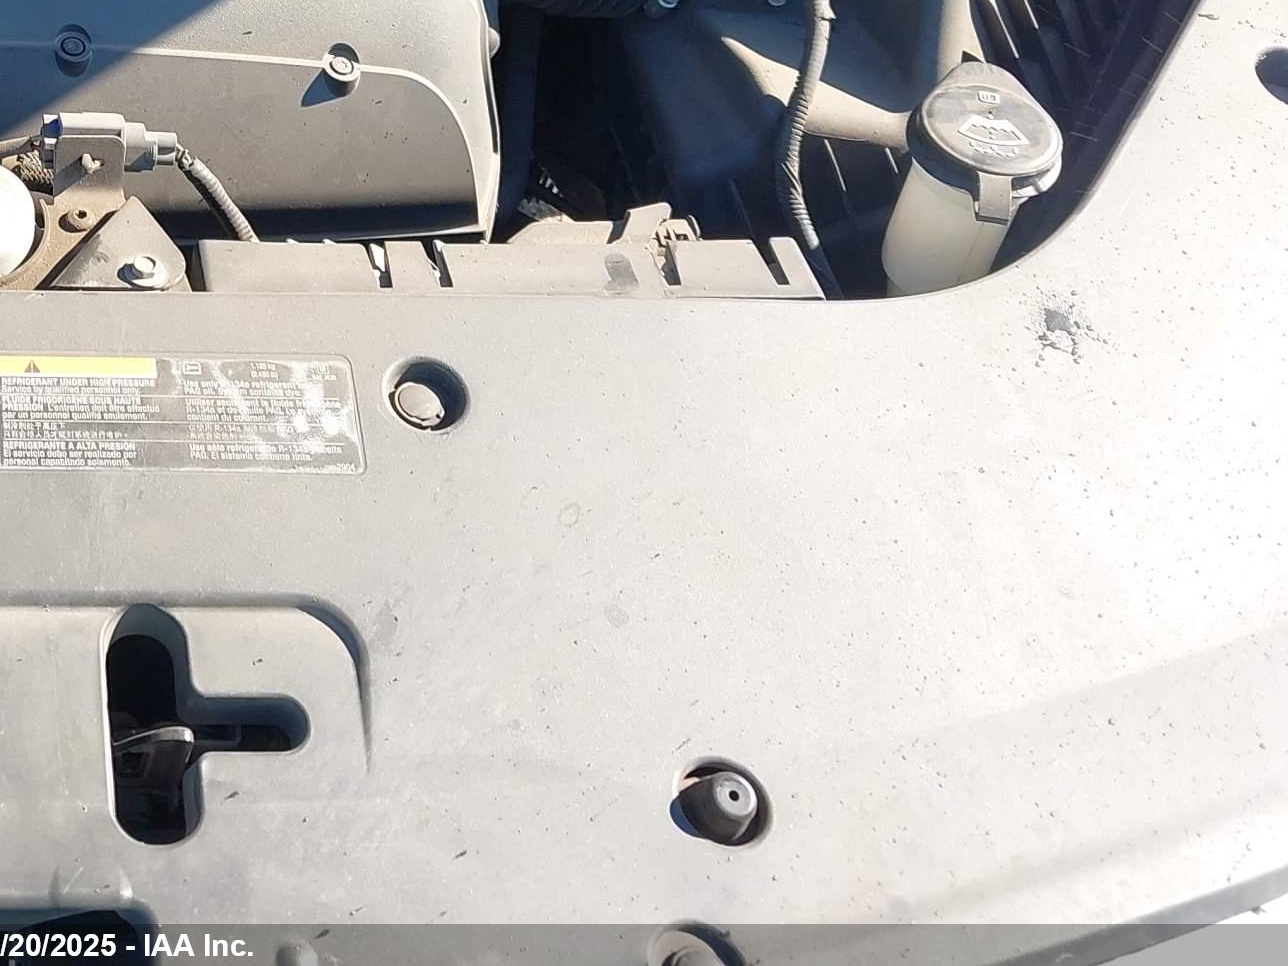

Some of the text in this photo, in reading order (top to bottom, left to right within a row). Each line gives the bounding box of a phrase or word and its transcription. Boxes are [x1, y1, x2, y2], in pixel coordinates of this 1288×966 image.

[1, 377, 58, 386] REFRIGERANT
[59, 378, 89, 386] UNDER
[112, 378, 155, 387] PRESSURE
[1, 385, 32, 394] Service
[33, 385, 43, 395] by
[45, 385, 79, 395] qualified
[113, 395, 141, 405] HAUTE
[3, 441, 66, 450] REFRIGERANTE
[68, 442, 75, 450] A
[76, 442, 97, 450] ALTA
